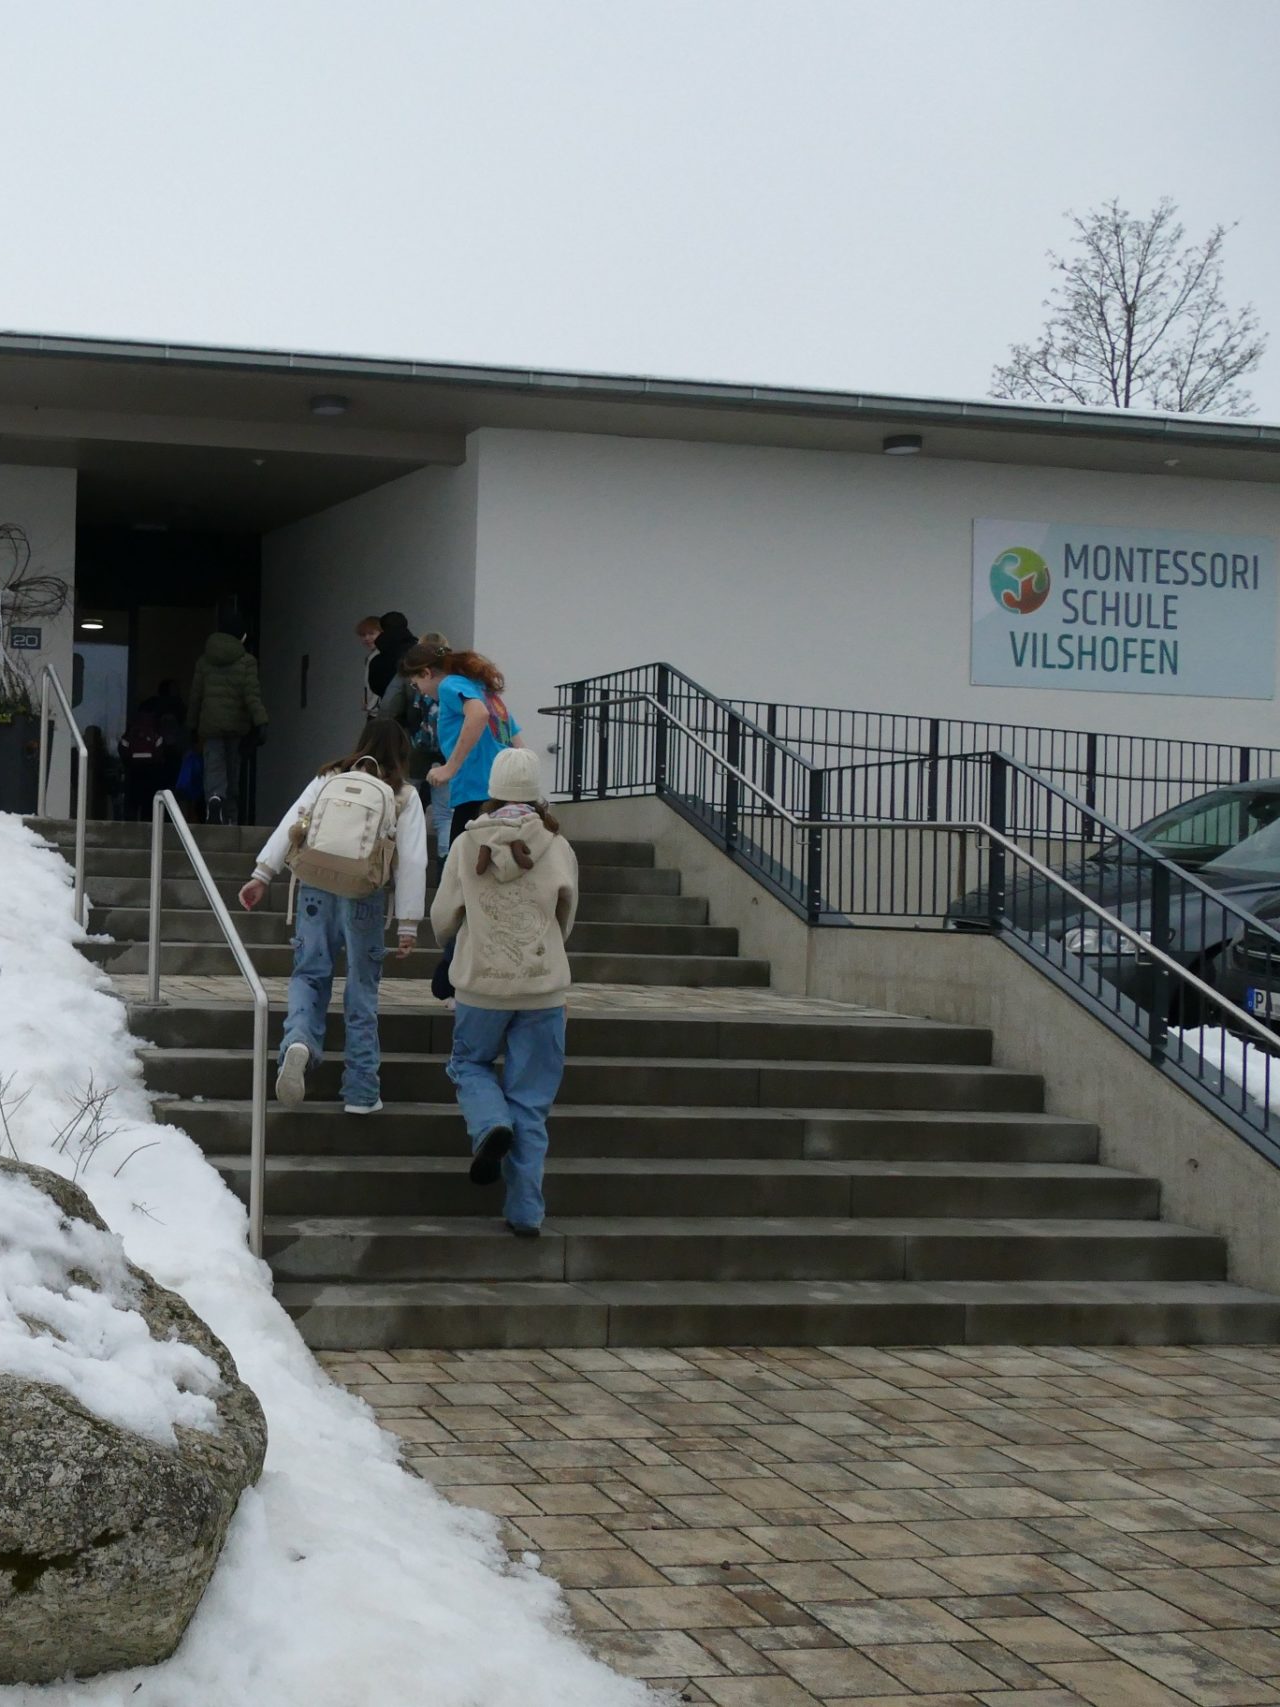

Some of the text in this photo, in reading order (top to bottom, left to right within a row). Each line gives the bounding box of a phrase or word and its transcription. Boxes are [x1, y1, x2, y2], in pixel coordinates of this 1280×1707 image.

[1063, 543, 1259, 590] MONTESSORI
[1061, 588, 1179, 630] SCHULE
[12, 634, 38, 647] 20
[1009, 630, 1179, 676] VILSHOFEN
